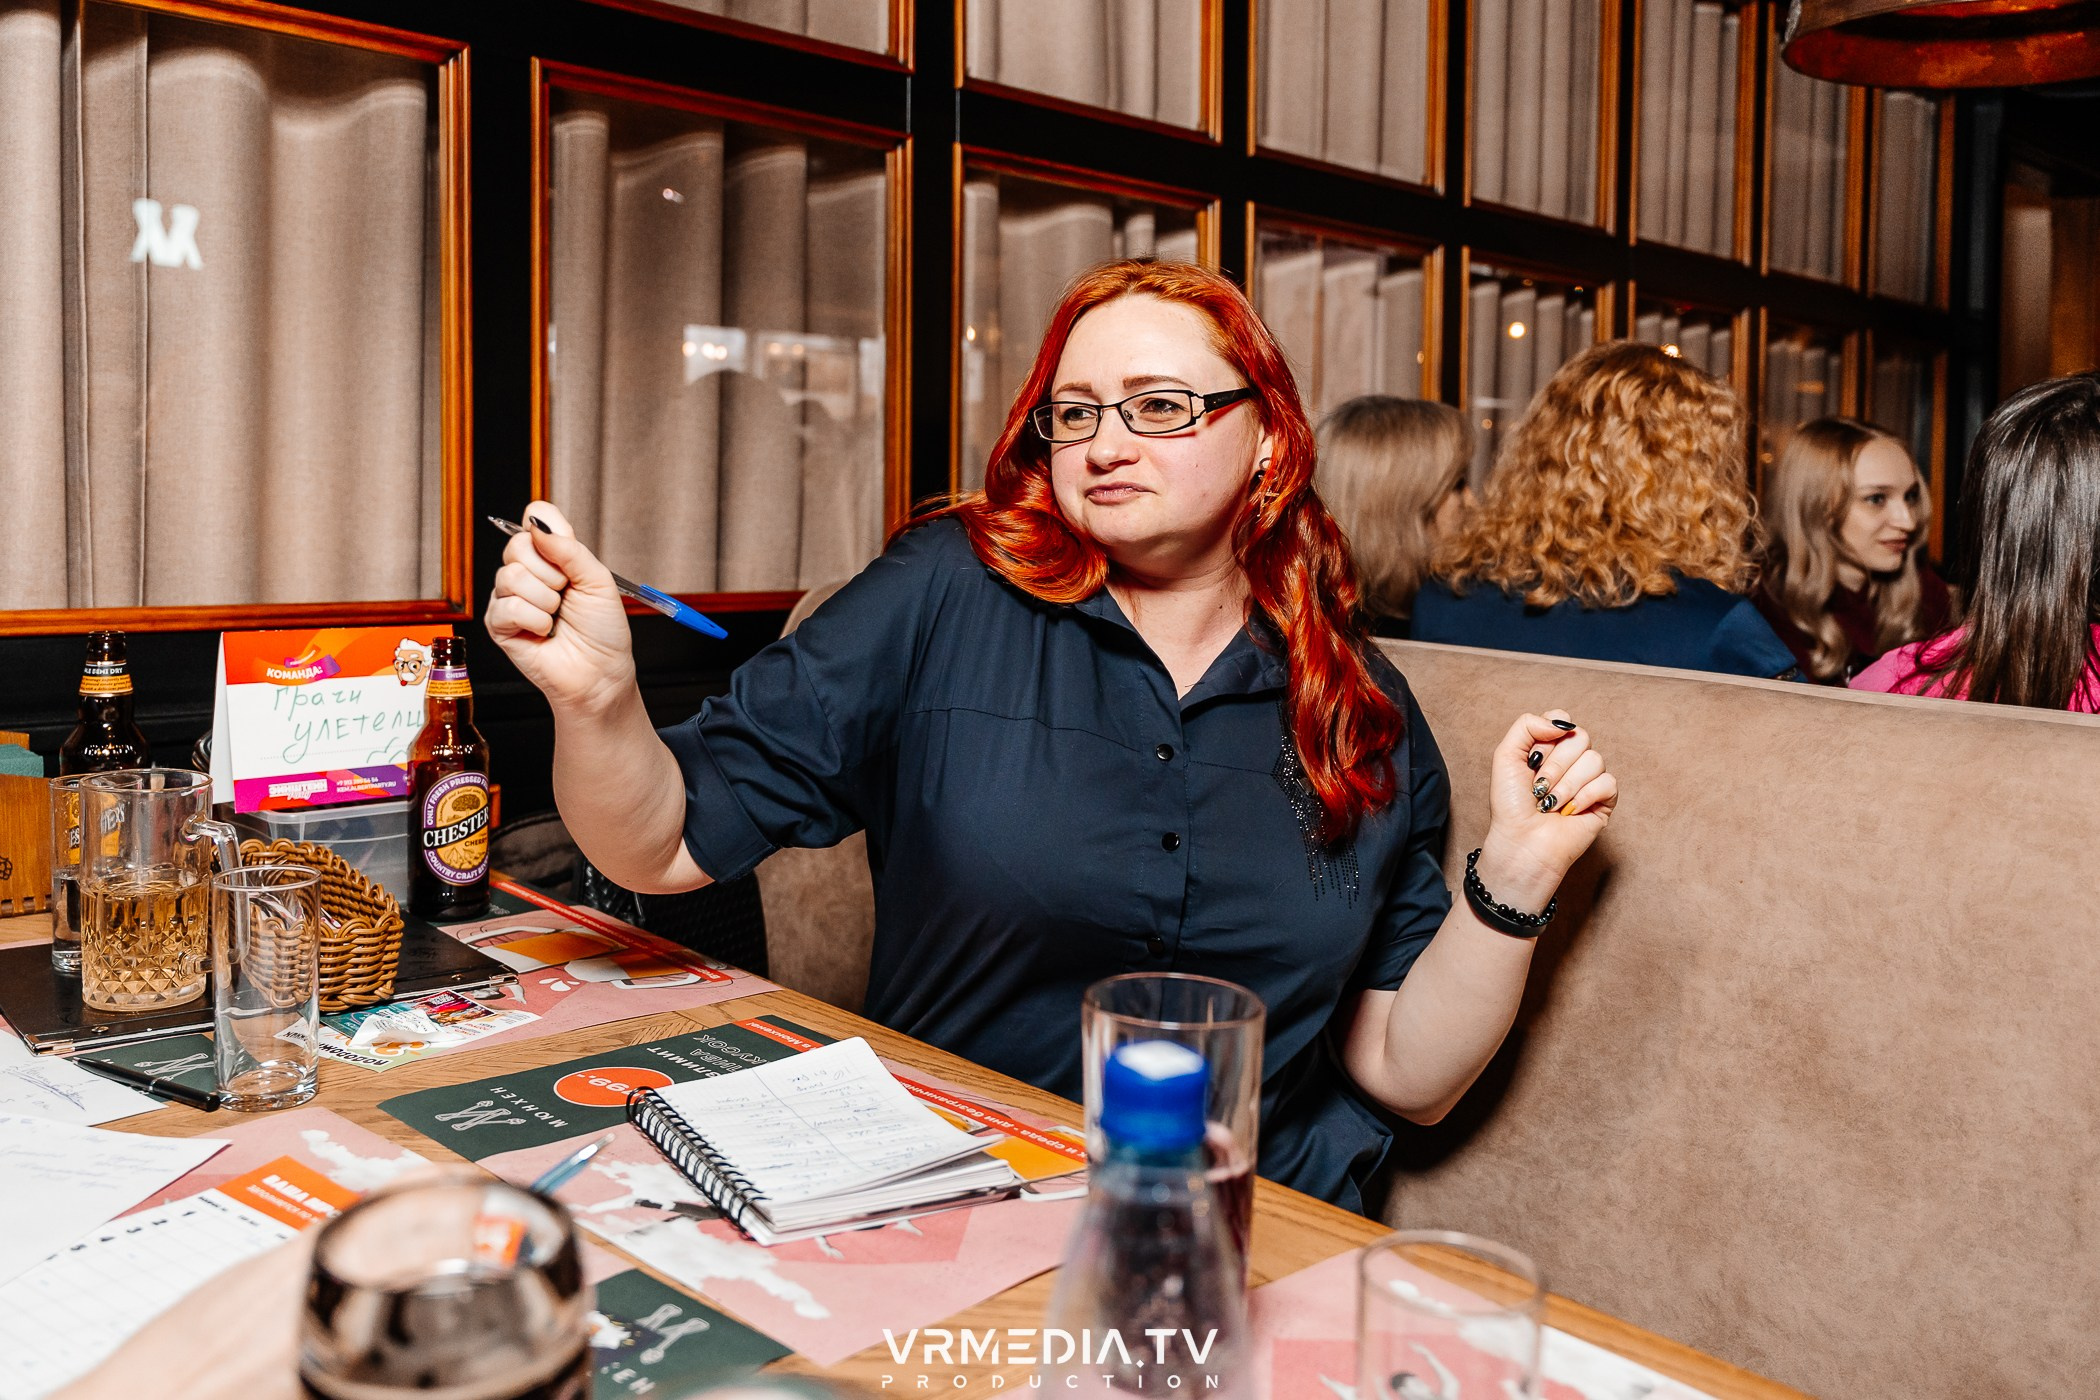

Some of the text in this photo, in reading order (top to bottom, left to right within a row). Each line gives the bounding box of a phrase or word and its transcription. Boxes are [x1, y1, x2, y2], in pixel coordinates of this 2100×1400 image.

[109, 667, 123, 675] DRY
[266, 665, 323, 680] КОМАНДА:
[449, 775, 481, 788] PRESSED
[429, 784, 450, 805] FRESH
[426, 804, 435, 826] ONLY
[428, 850, 456, 878] COUNTRY
[455, 869, 478, 880] CRAFT
[746, 1022, 803, 1045] Мюнхене!
[490, 1086, 569, 1128] МЮНХЕН
[984, 1115, 1014, 1129] дни
[1019, 1129, 1066, 1150] среда
